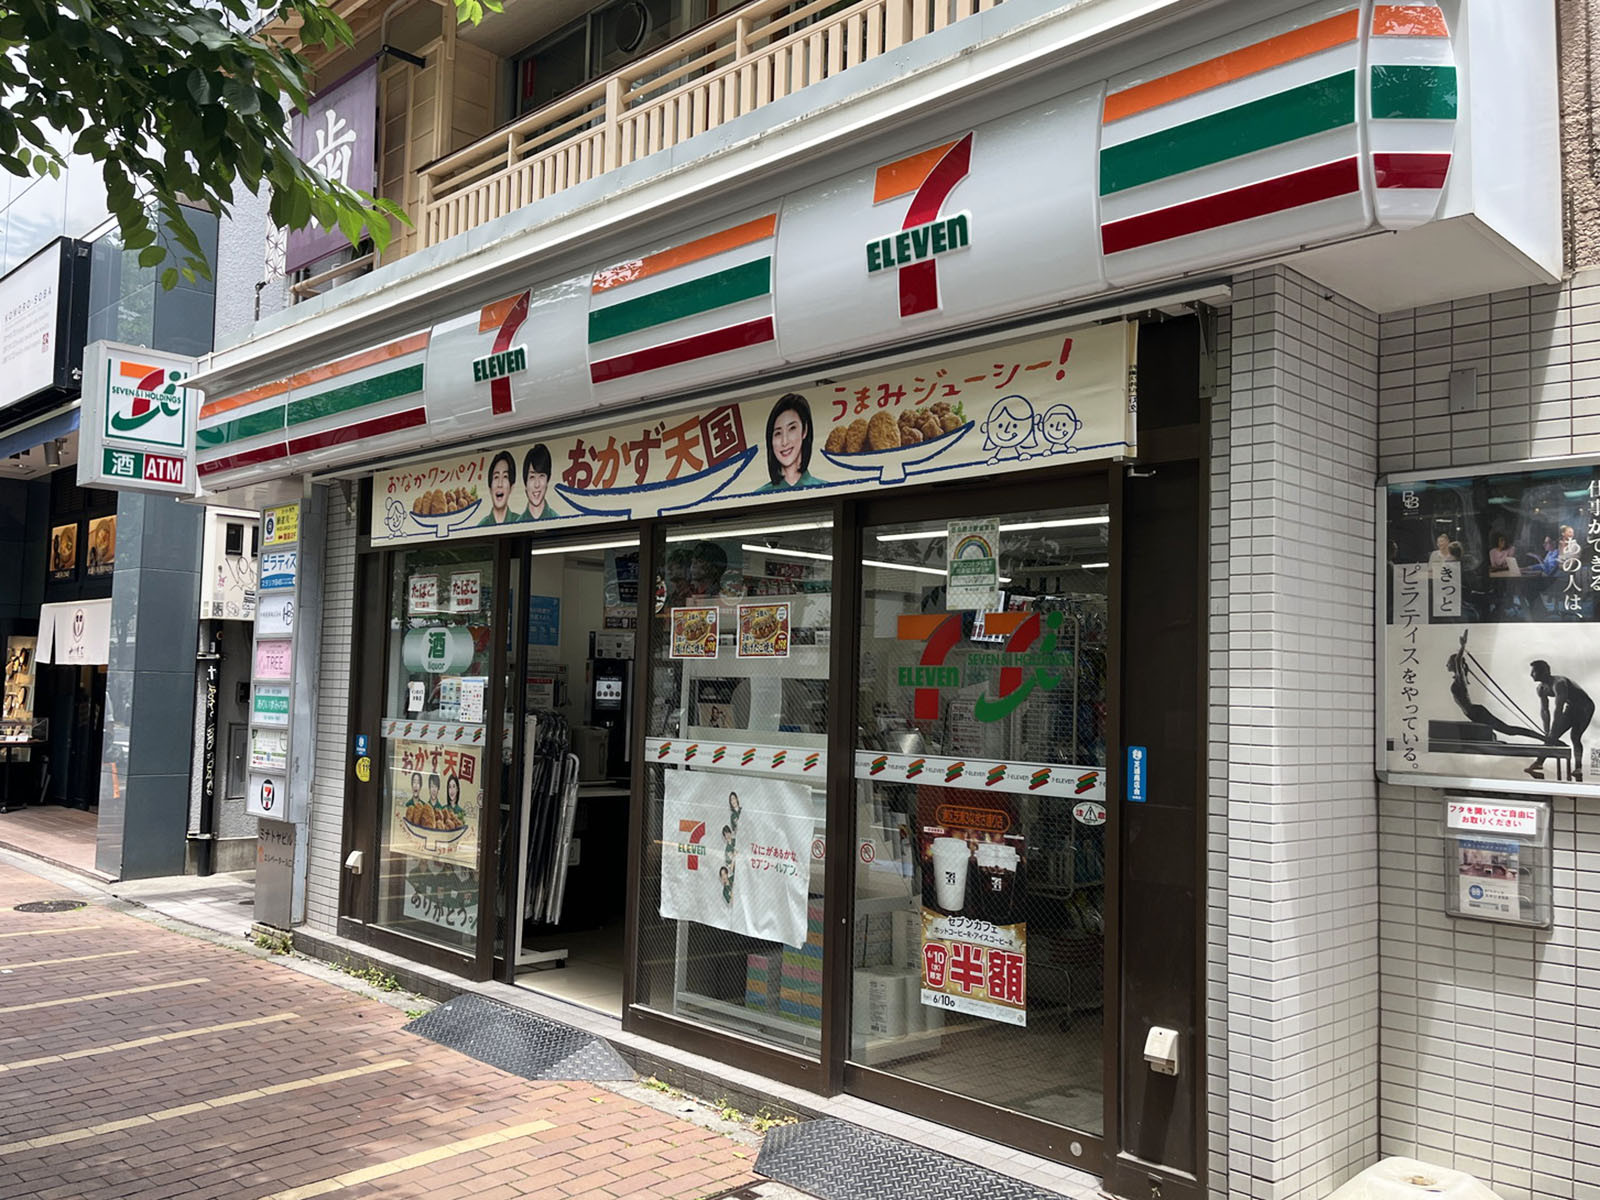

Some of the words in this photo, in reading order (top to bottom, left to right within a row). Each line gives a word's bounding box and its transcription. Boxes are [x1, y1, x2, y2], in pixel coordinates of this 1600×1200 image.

[562, 403, 748, 489] おかず天国
[111, 452, 135, 475] 酒
[146, 457, 181, 481] ATM
[412, 583, 435, 599] たばこ
[453, 580, 478, 595] たばこ
[1439, 566, 1456, 612] きっと
[428, 632, 446, 658] 酒
[428, 661, 446, 671] liquor
[1400, 565, 1420, 769] ピラティスをやっている。
[401, 744, 476, 784] おかず天国
[948, 918, 998, 935] セブンカフェ
[950, 943, 1025, 1006] 半額
